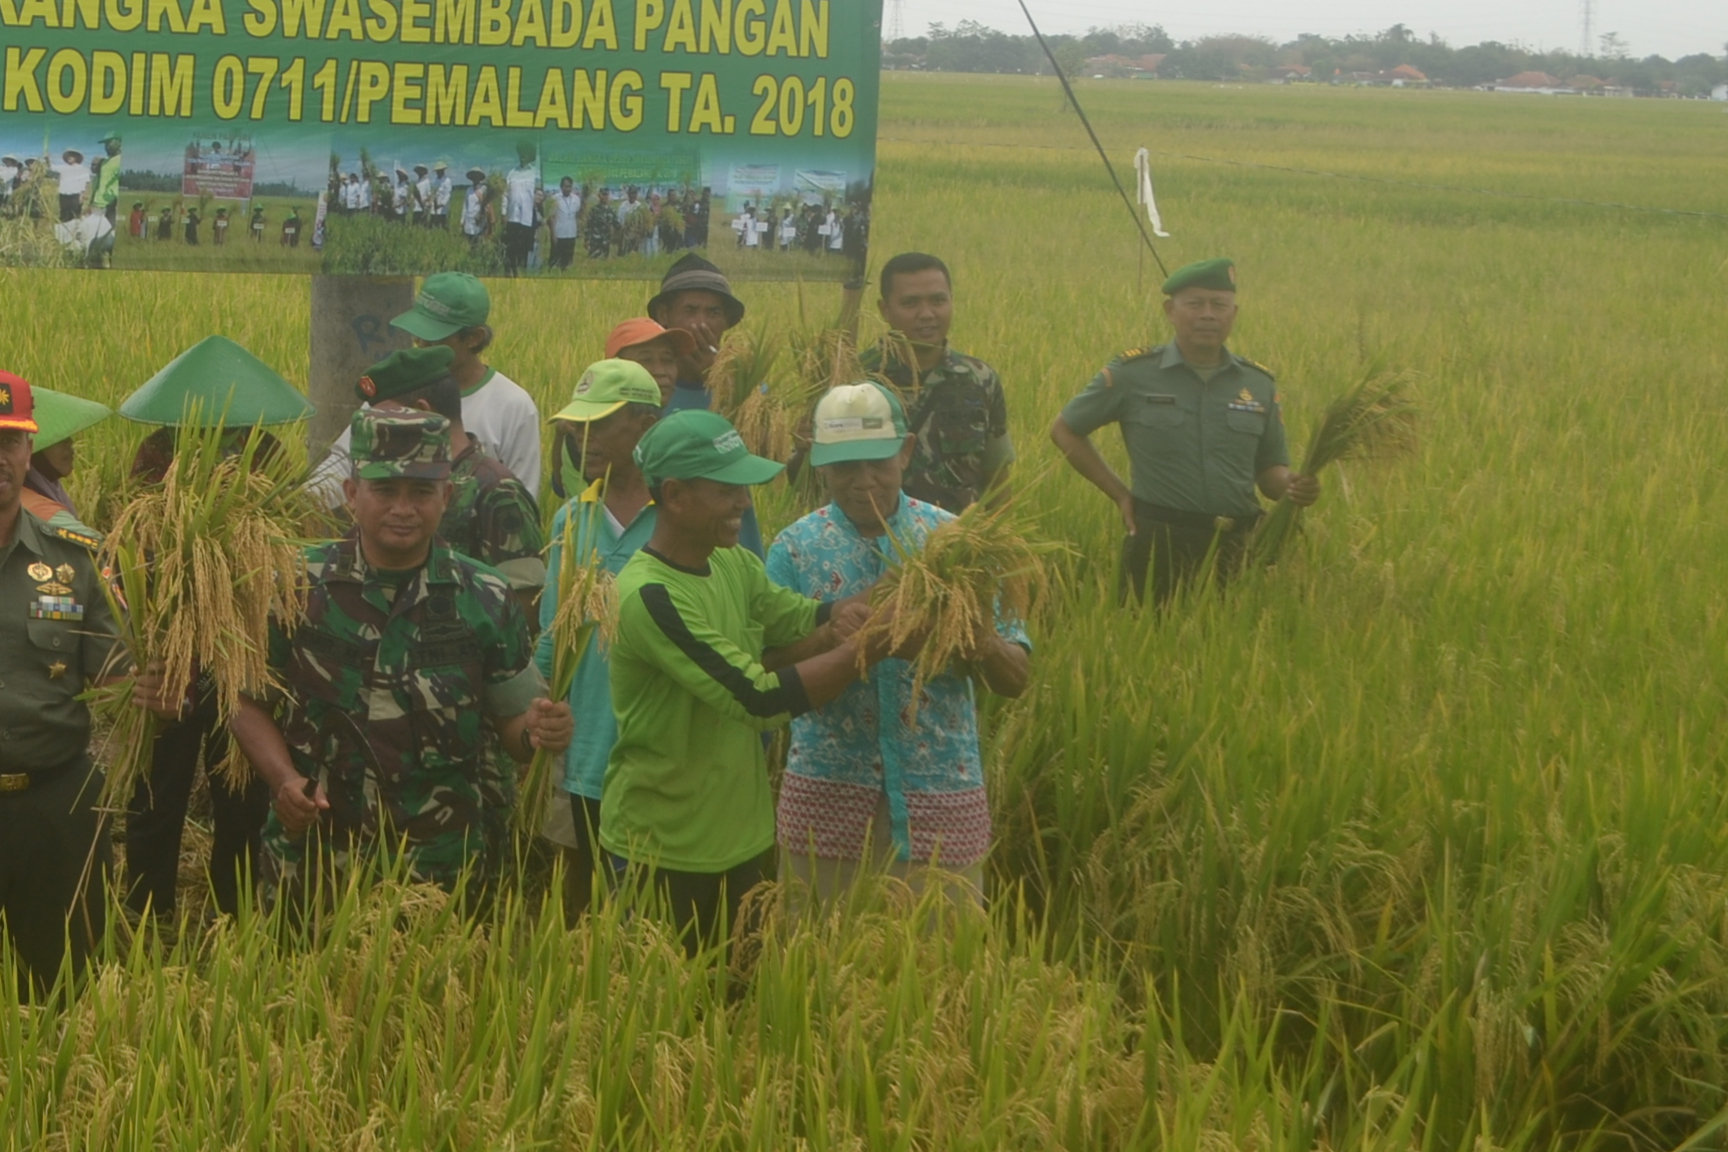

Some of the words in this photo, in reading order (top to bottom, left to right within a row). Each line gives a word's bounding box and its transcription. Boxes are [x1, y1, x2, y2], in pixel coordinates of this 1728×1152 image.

[2, 46, 196, 118] KODIM
[211, 54, 644, 133] 0711/PEMALANG
[659, 70, 736, 135] TA.
[749, 73, 856, 139] 2018
